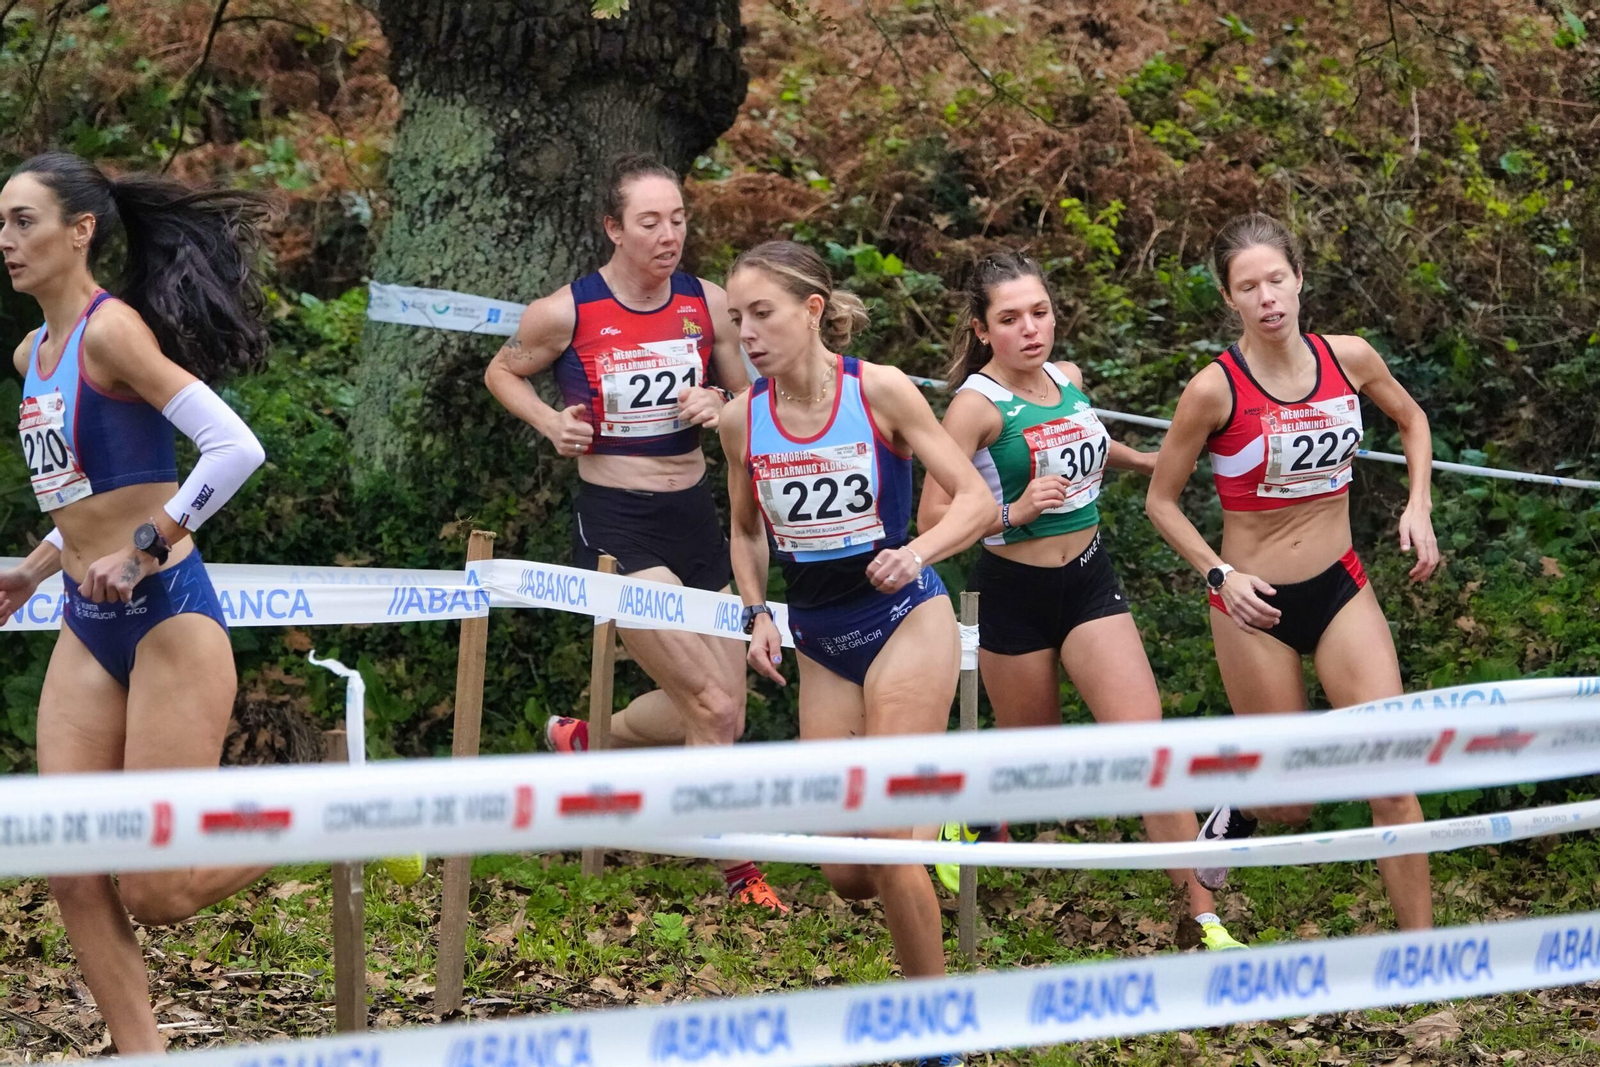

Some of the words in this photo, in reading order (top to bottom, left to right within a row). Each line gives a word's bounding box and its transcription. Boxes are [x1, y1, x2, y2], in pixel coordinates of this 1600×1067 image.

[613, 348, 652, 361] MEMORIAL
[614, 359, 658, 373] BELARMINO
[629, 367, 697, 409] 221
[1280, 409, 1321, 421] MEMORIAL
[1281, 419, 1323, 433] BELARMINO
[24, 428, 69, 476] 220
[769, 451, 812, 465] MEMORIAL
[1060, 436, 1107, 482] 301
[1290, 427, 1360, 472] 222
[770, 463, 818, 479] BELARMINO
[782, 473, 874, 523] 223
[1080, 540, 1098, 567] NIKE
[832, 629, 862, 645] XUNTA
[837, 642, 849, 652] DE
[848, 629, 882, 649] GALICIA
